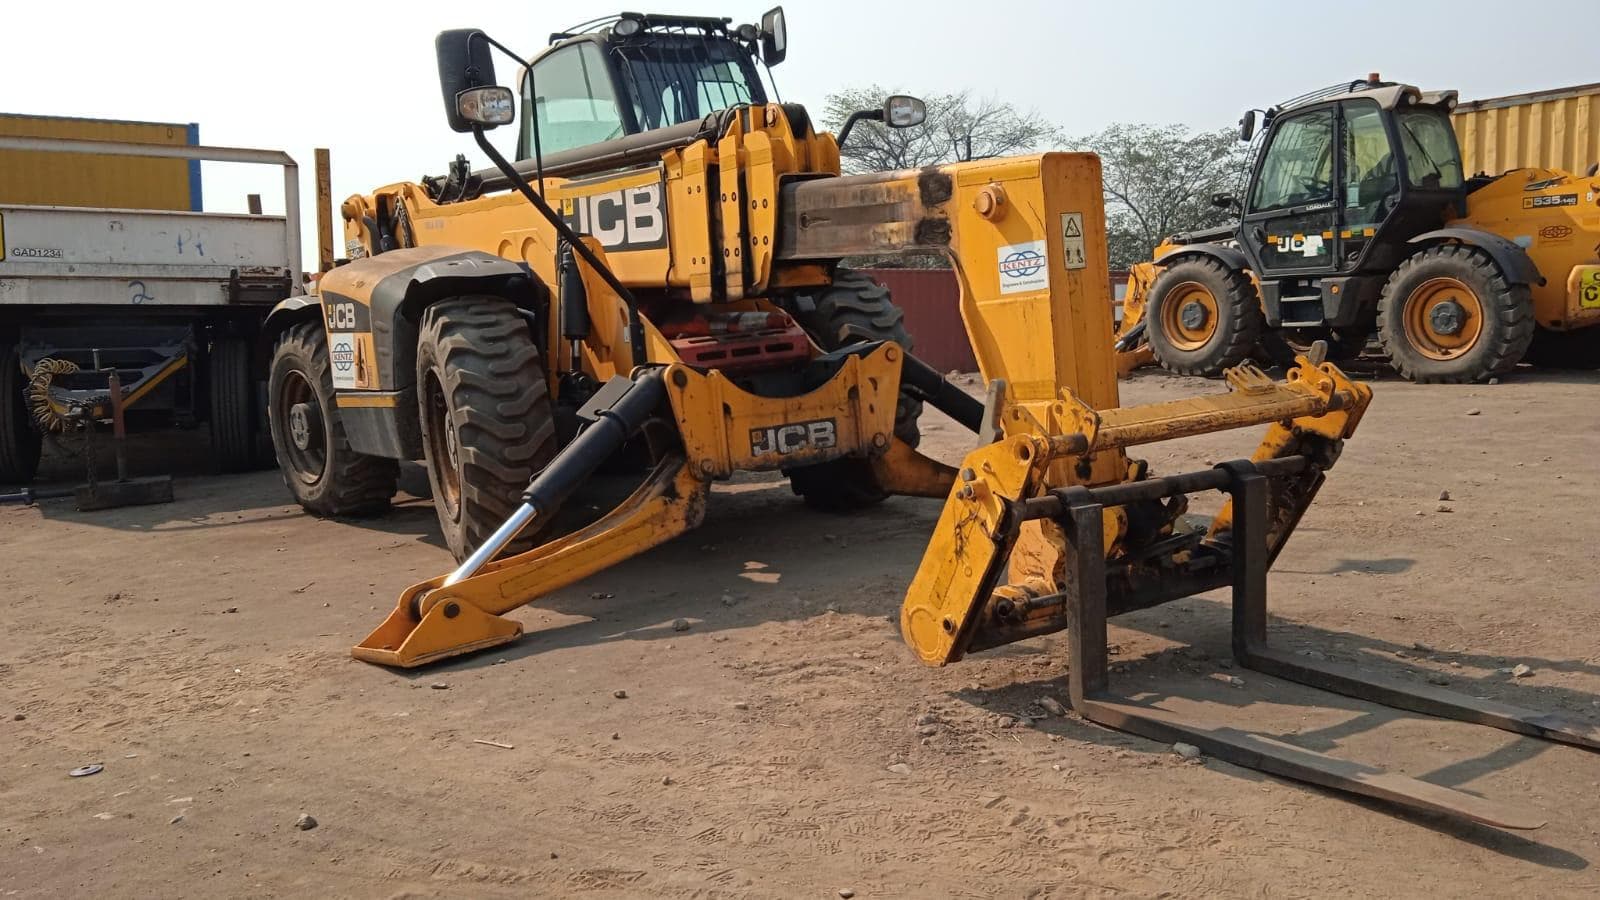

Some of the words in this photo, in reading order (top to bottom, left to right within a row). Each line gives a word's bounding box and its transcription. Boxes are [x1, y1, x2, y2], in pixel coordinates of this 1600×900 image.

[563, 184, 663, 246] JCB
[12, 247, 62, 258] GAD1234
[1003, 258, 1041, 271] KENTZ
[128, 280, 155, 304] 2
[328, 302, 356, 329] JCB
[333, 352, 353, 361] KENTZ
[751, 421, 836, 457] JCB
